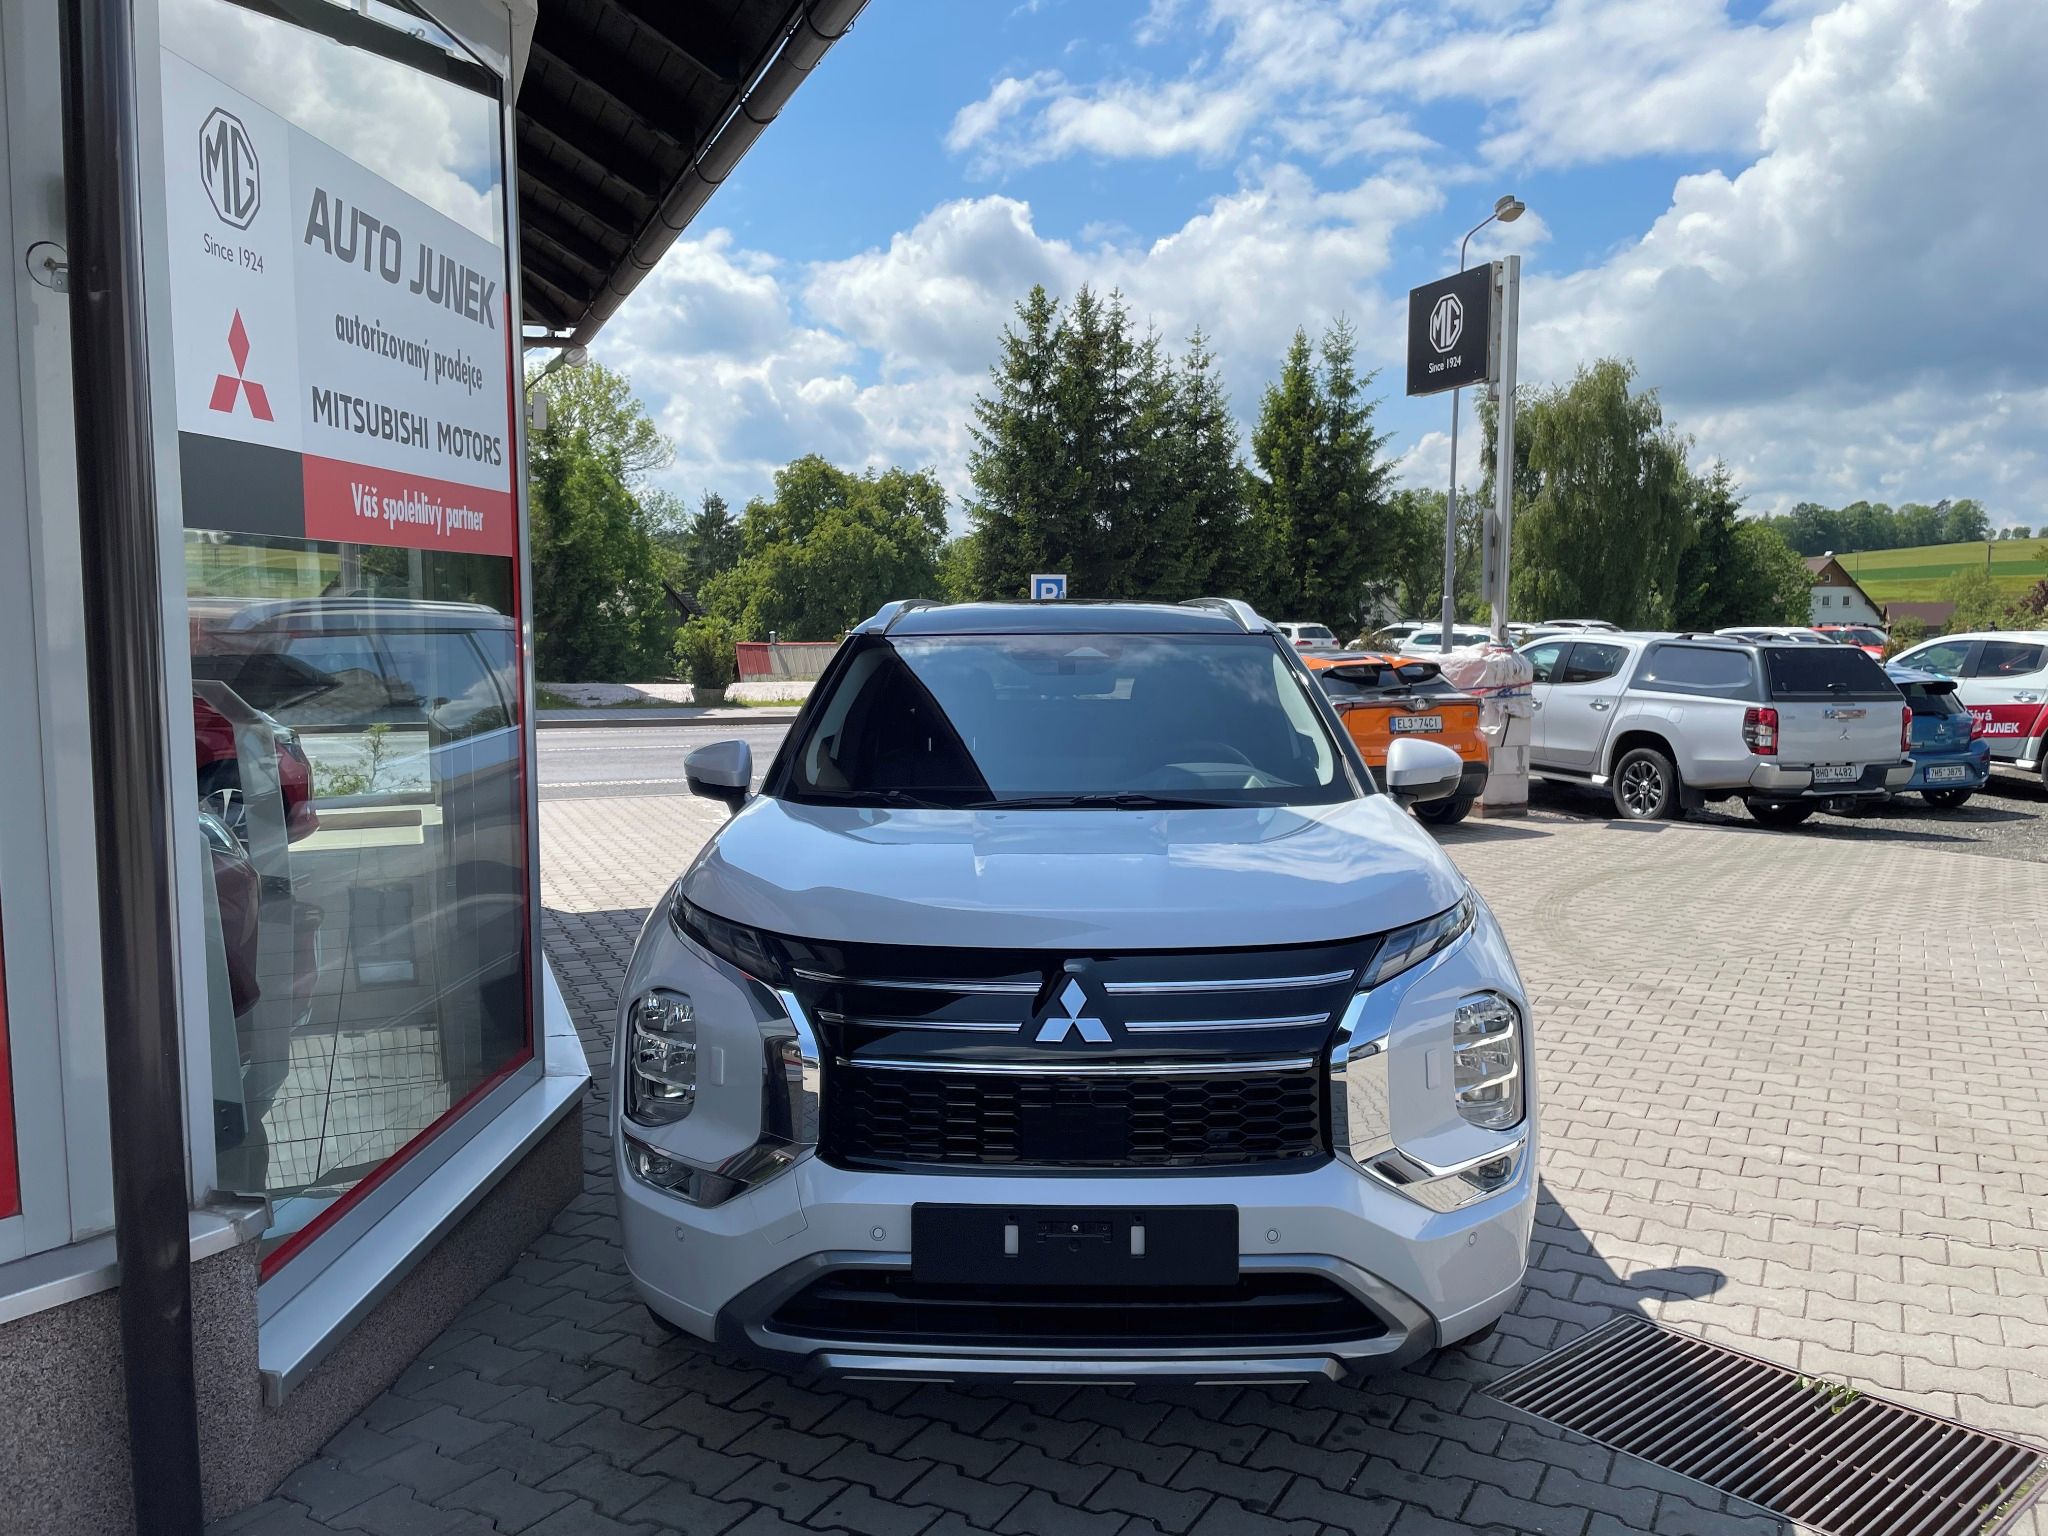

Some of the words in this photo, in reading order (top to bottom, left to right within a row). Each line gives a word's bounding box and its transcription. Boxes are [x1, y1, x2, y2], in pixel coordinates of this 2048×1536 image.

[203, 117, 257, 222] MG
[203, 232, 234, 263] Since
[238, 245, 264, 275] 1924
[304, 186, 401, 285] AUTO
[409, 243, 497, 330] JUNEK
[1432, 298, 1462, 348] MG
[335, 312, 431, 381] autorizovaný
[434, 352, 483, 396] prodejce
[1428, 361, 1445, 374] Since
[1446, 354, 1462, 370] 1924
[311, 386, 429, 450] MITSUBISHI
[437, 421, 502, 466] MOTORS
[351, 481, 379, 519] Váš
[383, 491, 443, 537] spolehlivý
[445, 504, 484, 533] partner
[1040, 583, 1059, 599] P
[1397, 718, 1413, 729] EL3
[1983, 722, 2020, 734] JUNEK
